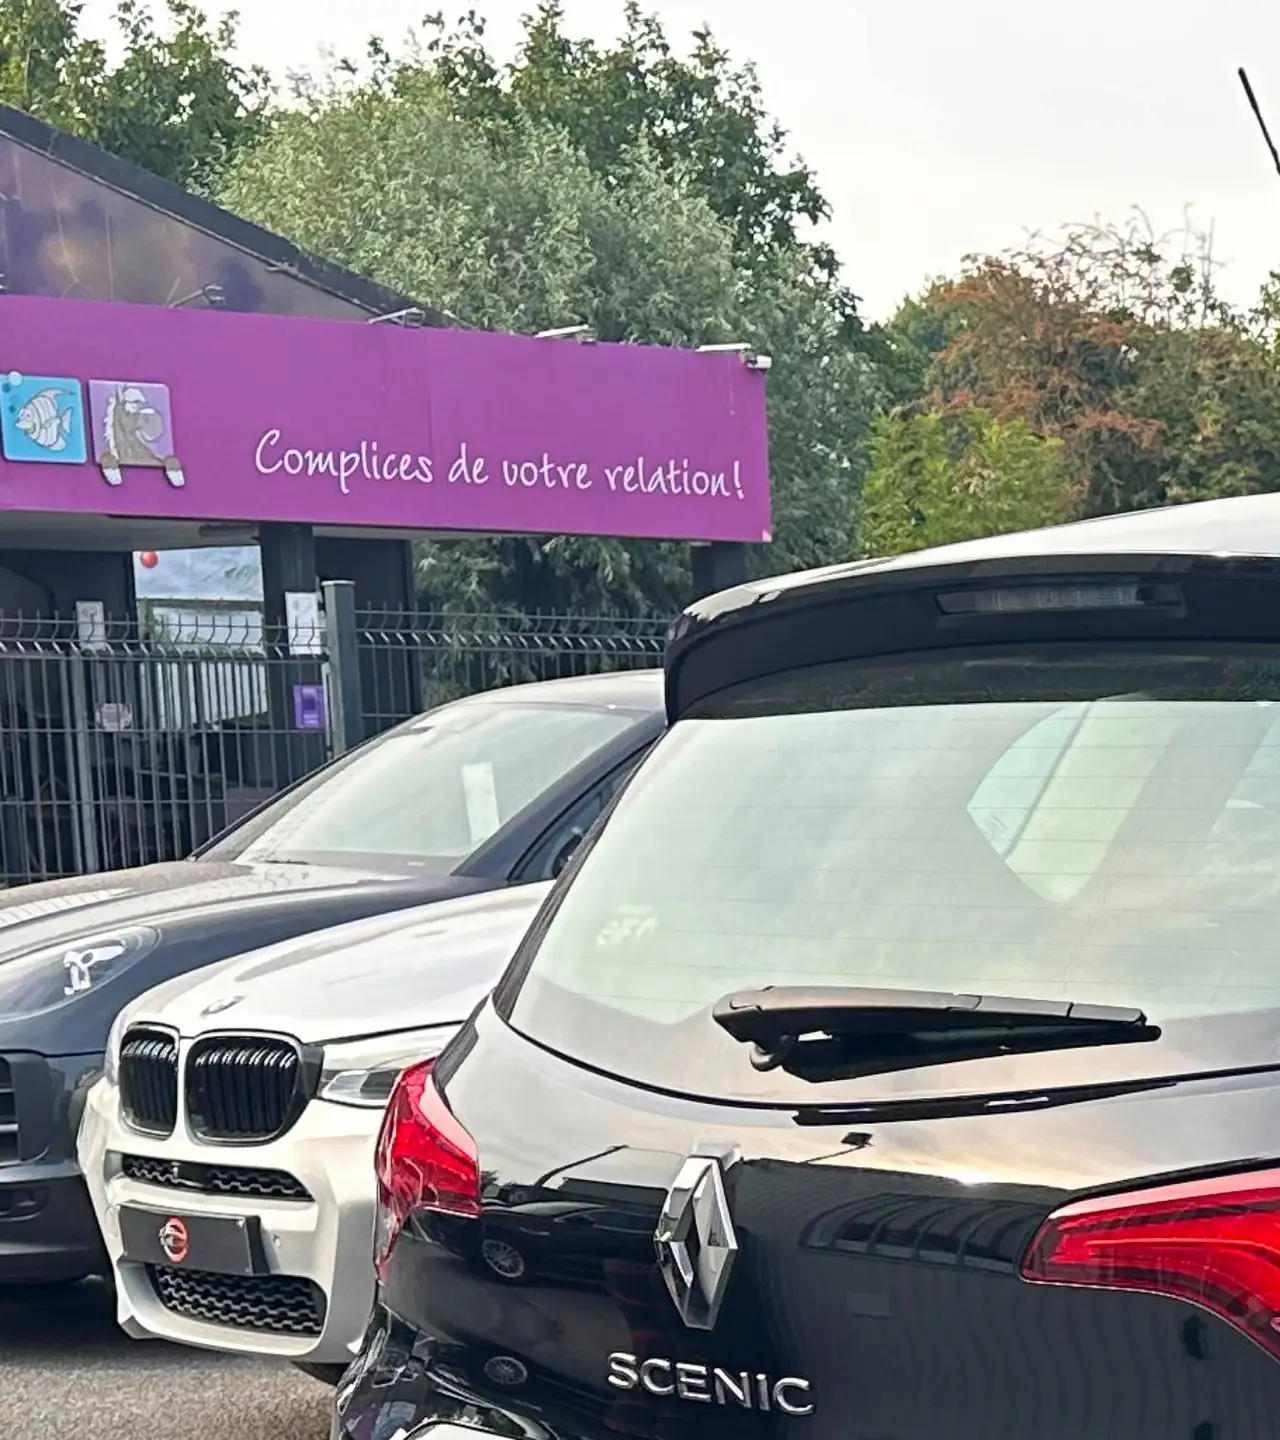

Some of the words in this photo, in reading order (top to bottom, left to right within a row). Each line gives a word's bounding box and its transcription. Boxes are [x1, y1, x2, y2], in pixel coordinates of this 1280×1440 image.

[254, 428, 434, 494] Complices
[447, 442, 490, 484] de
[502, 452, 593, 489] votre
[603, 456, 745, 500] relation!
[607, 1351, 816, 1416] SCENIC
